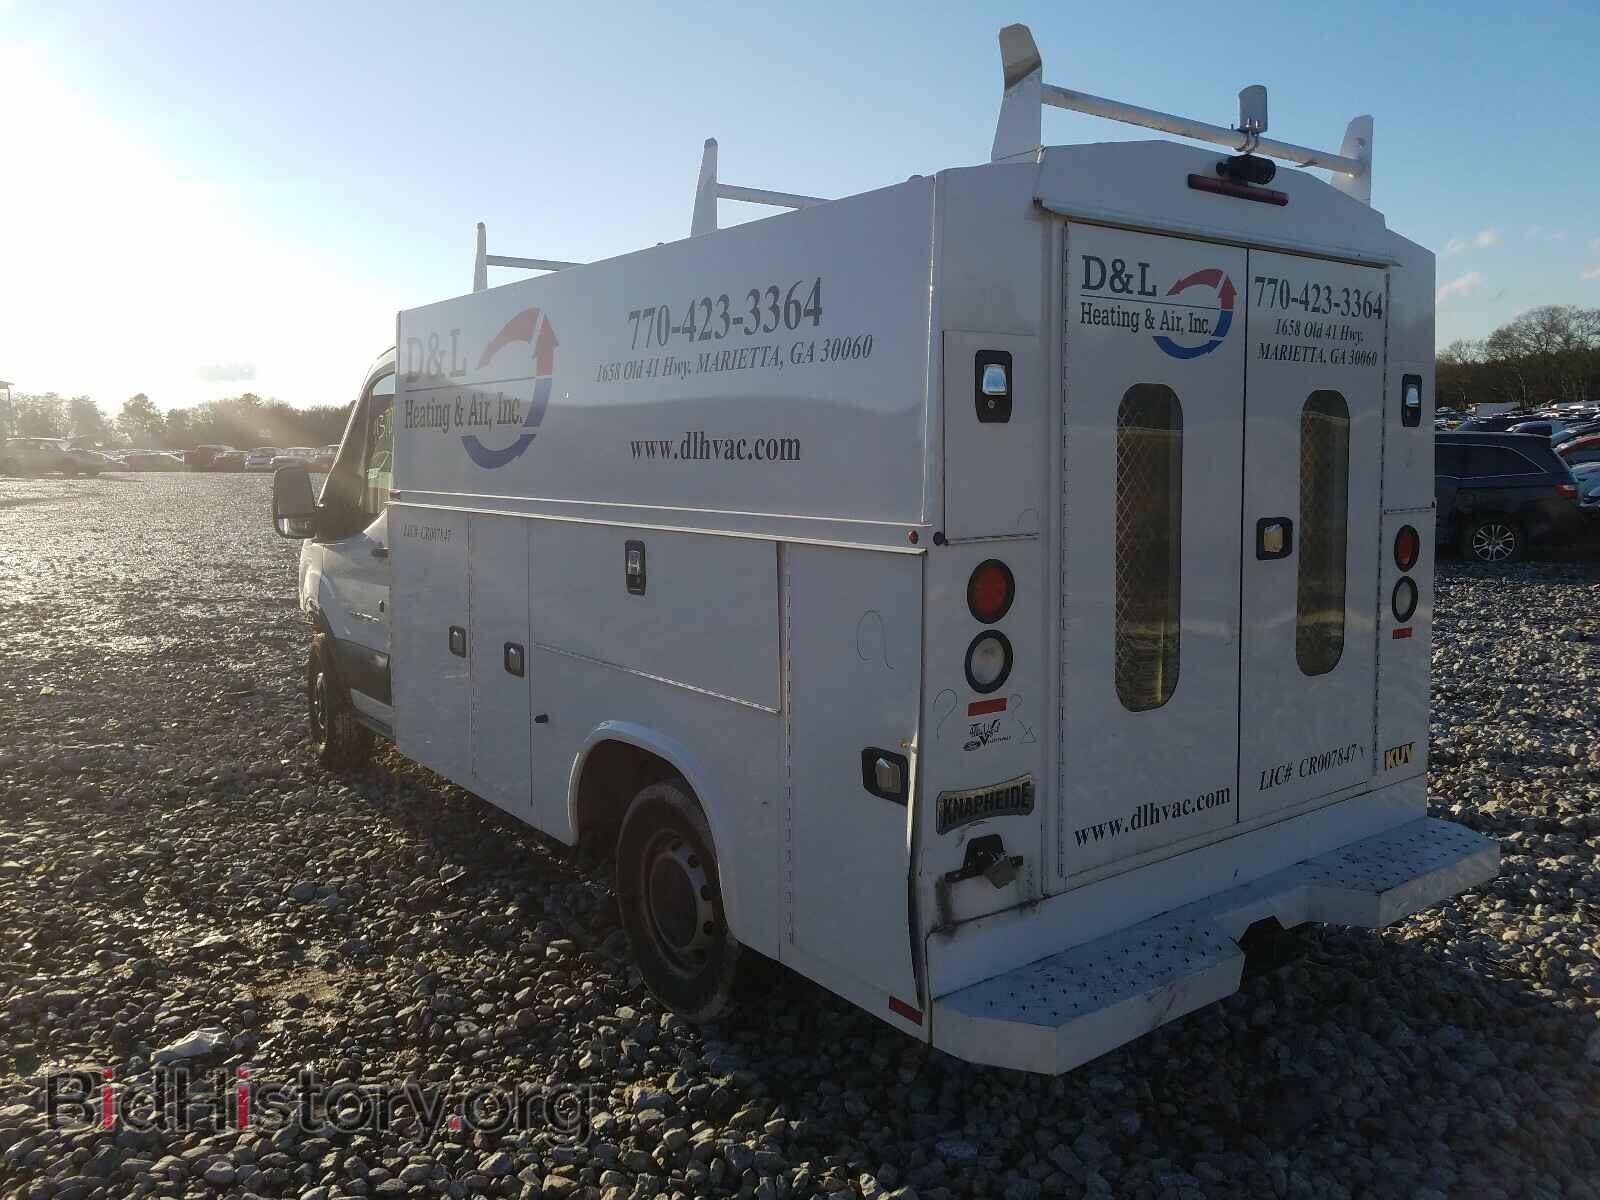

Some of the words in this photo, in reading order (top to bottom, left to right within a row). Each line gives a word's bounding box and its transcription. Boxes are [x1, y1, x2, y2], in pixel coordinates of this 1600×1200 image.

[1081, 254, 1157, 297] D&L
[628, 277, 823, 350] 770-423-3364
[1080, 301, 1139, 333] Heating
[1144, 311, 1155, 331] &
[1160, 312, 1184, 336] Air,
[1188, 314, 1212, 336] Inc.
[1254, 276, 1383, 320] 770-423-3364
[1273, 318, 1301, 336] 1658
[1303, 320, 1322, 338] Old
[1325, 322, 1337, 339] 41
[405, 328, 467, 383] D&L
[597, 361, 621, 383] 1658
[624, 359, 642, 381] Old
[645, 358, 660, 378] 41
[696, 345, 783, 374] MARIETTA,
[790, 341, 815, 366] GA
[820, 334, 873, 363] 30060
[1330, 346, 1349, 366] GA
[1349, 348, 1378, 368] 30060
[404, 393, 451, 434] Heating
[454, 394, 464, 426] &
[468, 390, 492, 433] Air,
[496, 392, 523, 425] Inc.
[630, 431, 801, 461] www.dlhvac.com
[1258, 762, 1293, 792] LIC#
[1074, 786, 1231, 848] www.dlhvac.com
